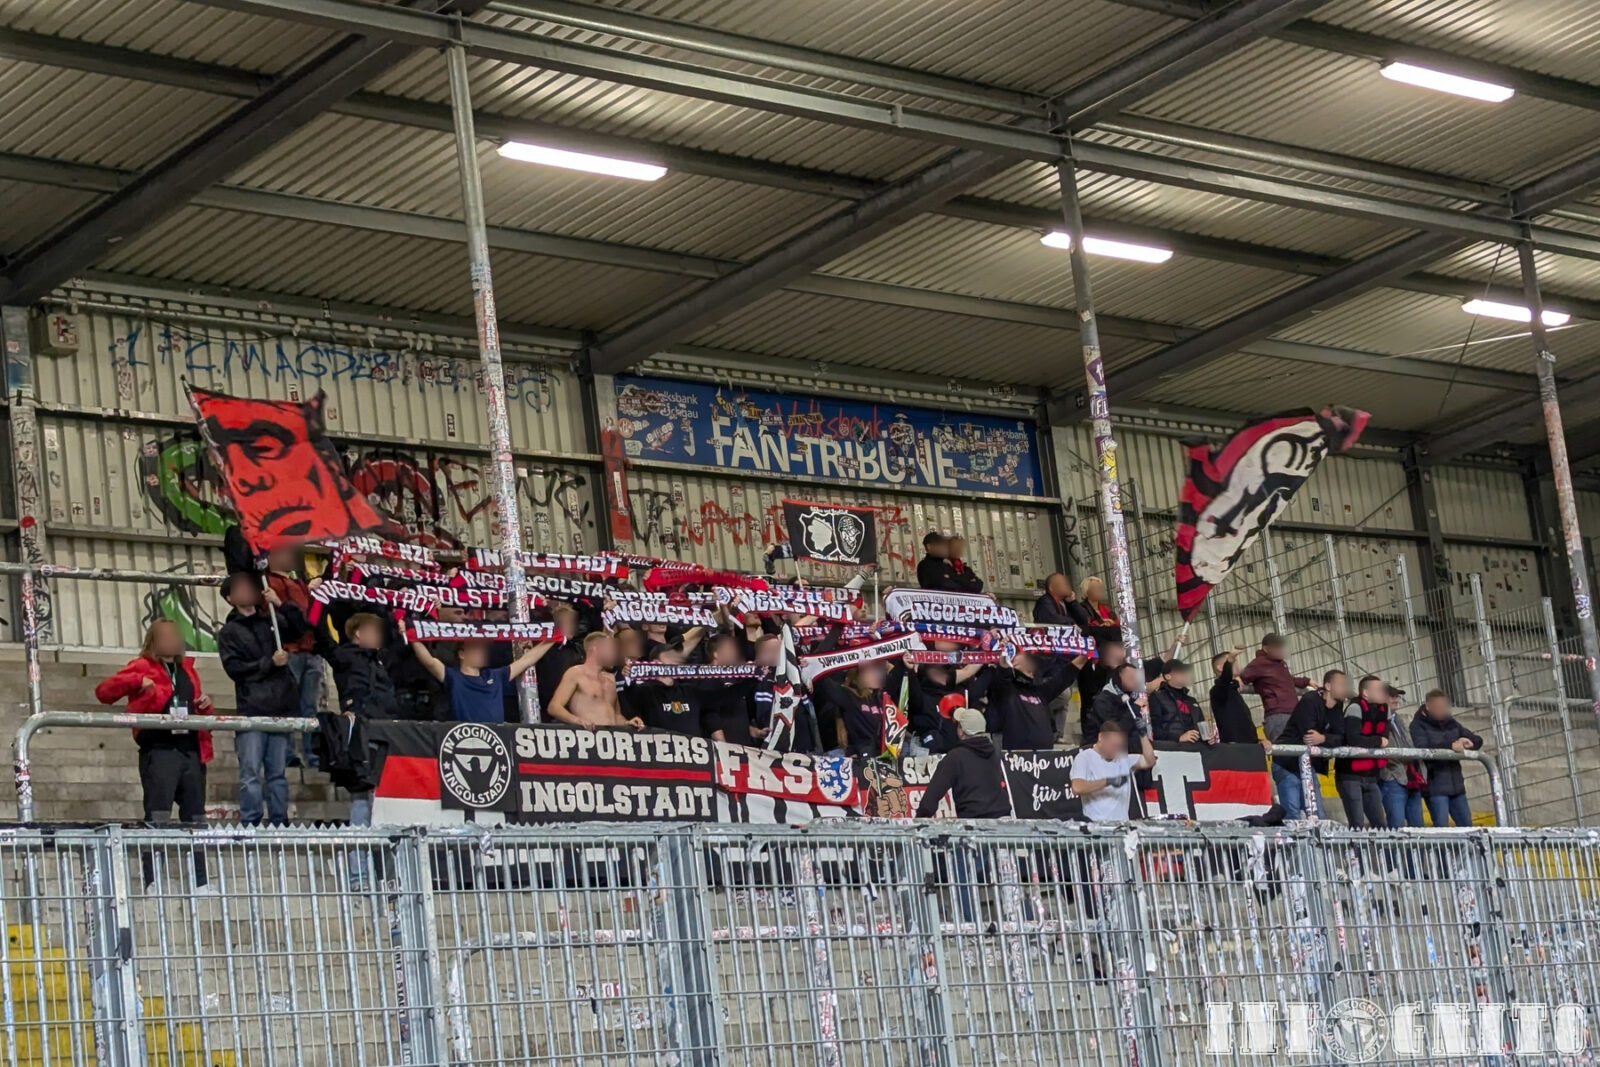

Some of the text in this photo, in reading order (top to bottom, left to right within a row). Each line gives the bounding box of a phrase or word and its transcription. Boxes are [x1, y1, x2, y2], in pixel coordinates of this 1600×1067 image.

[710, 413, 958, 488] FAN-TRIBUNE
[476, 550, 622, 574] INOLSTADT
[413, 620, 556, 639] INGOLSTADT
[630, 665, 697, 678] SUPPORTERS
[443, 726, 504, 756] IN KOGNITO
[515, 727, 710, 765] SUPPORTERS
[714, 741, 814, 795] FKS
[445, 772, 506, 804] INGOLSTADT
[519, 781, 714, 818] INGOLSTADT
[1031, 782, 1062, 812] für
